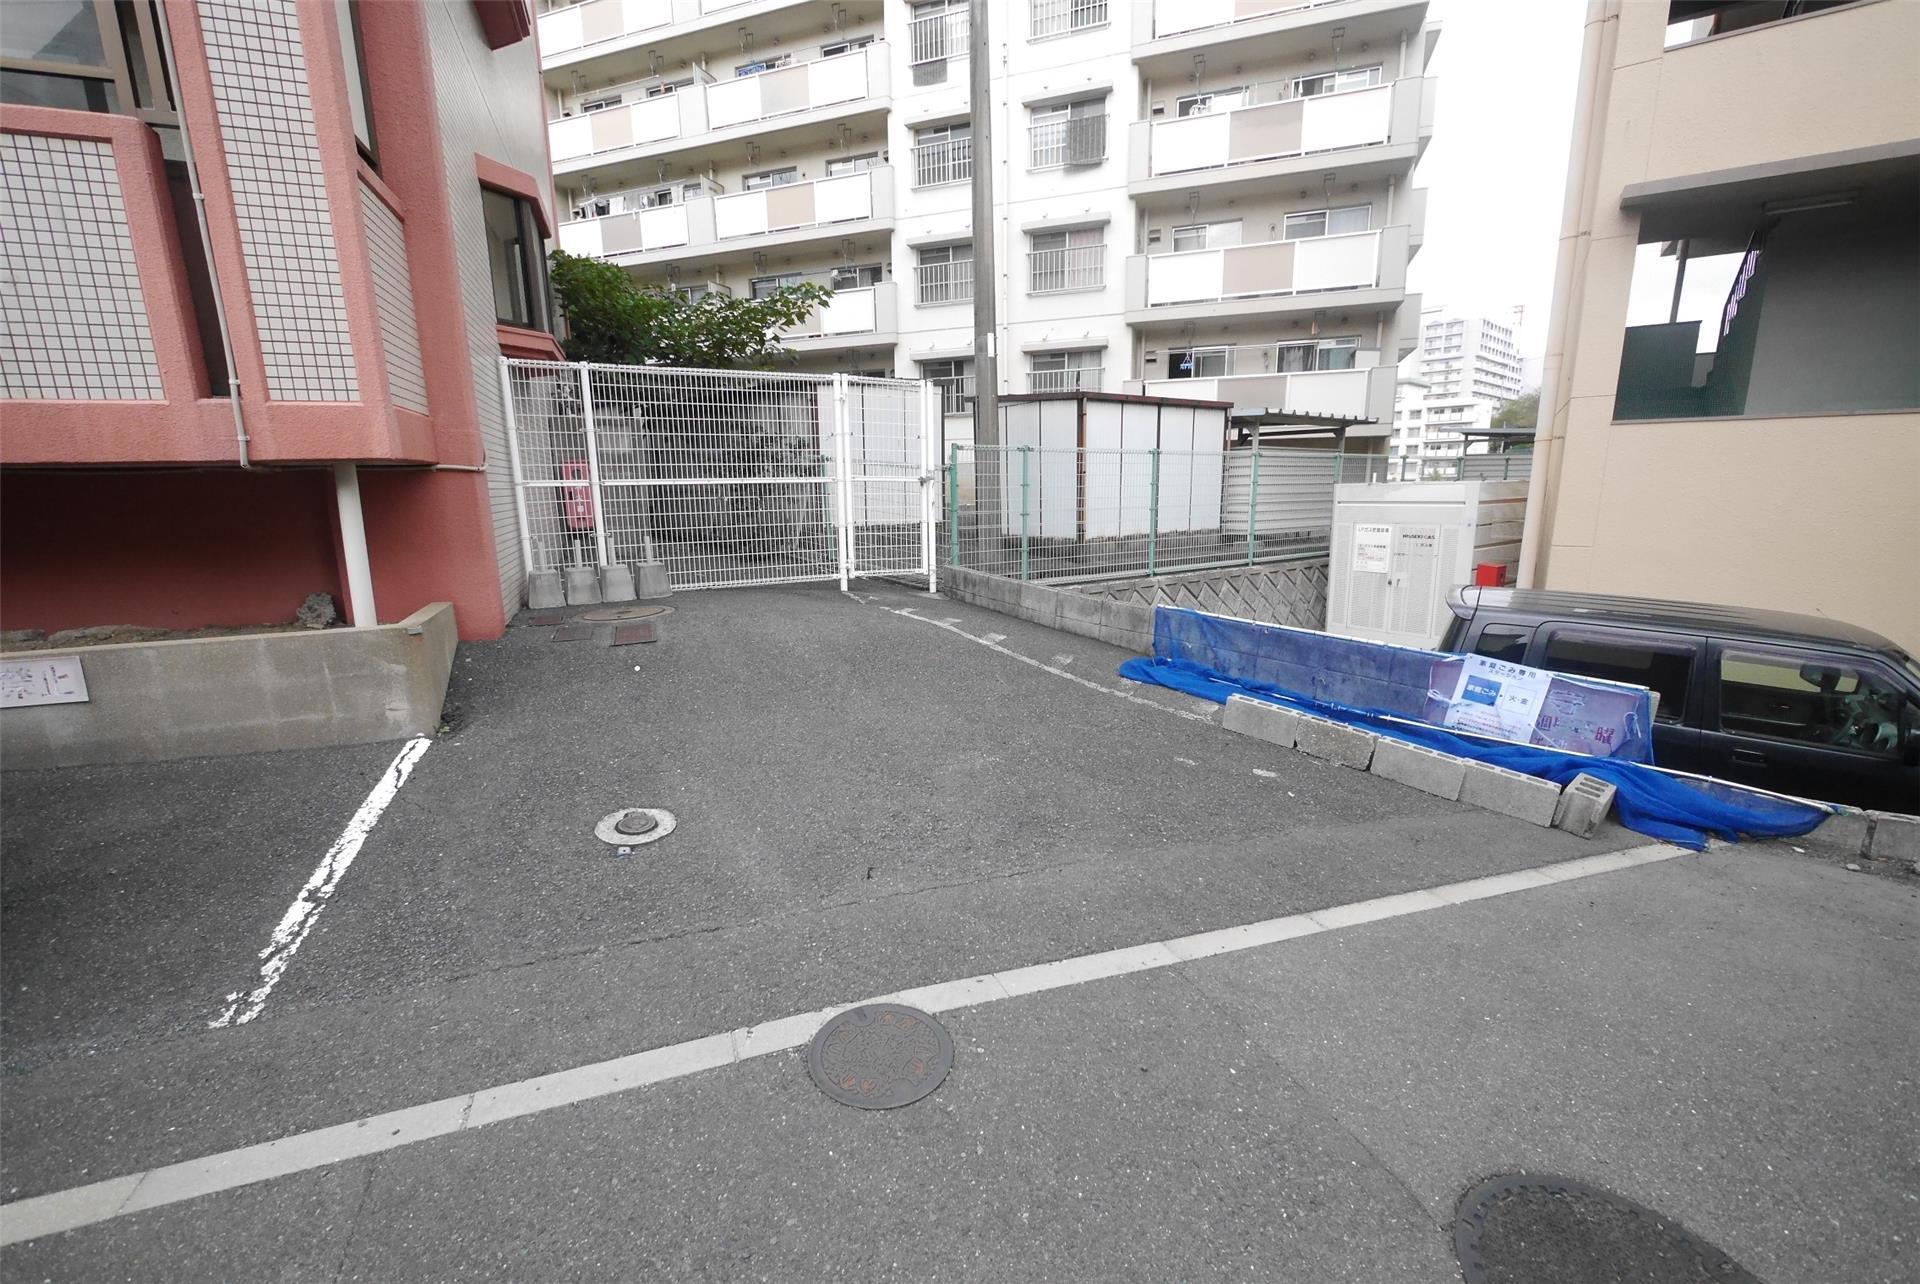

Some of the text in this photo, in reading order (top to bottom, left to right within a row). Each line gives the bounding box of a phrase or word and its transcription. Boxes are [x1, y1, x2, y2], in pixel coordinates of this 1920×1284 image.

[1479, 660, 1537, 679] 家庭ごみ専用
[1466, 684, 1497, 697] 家庭ごみ
